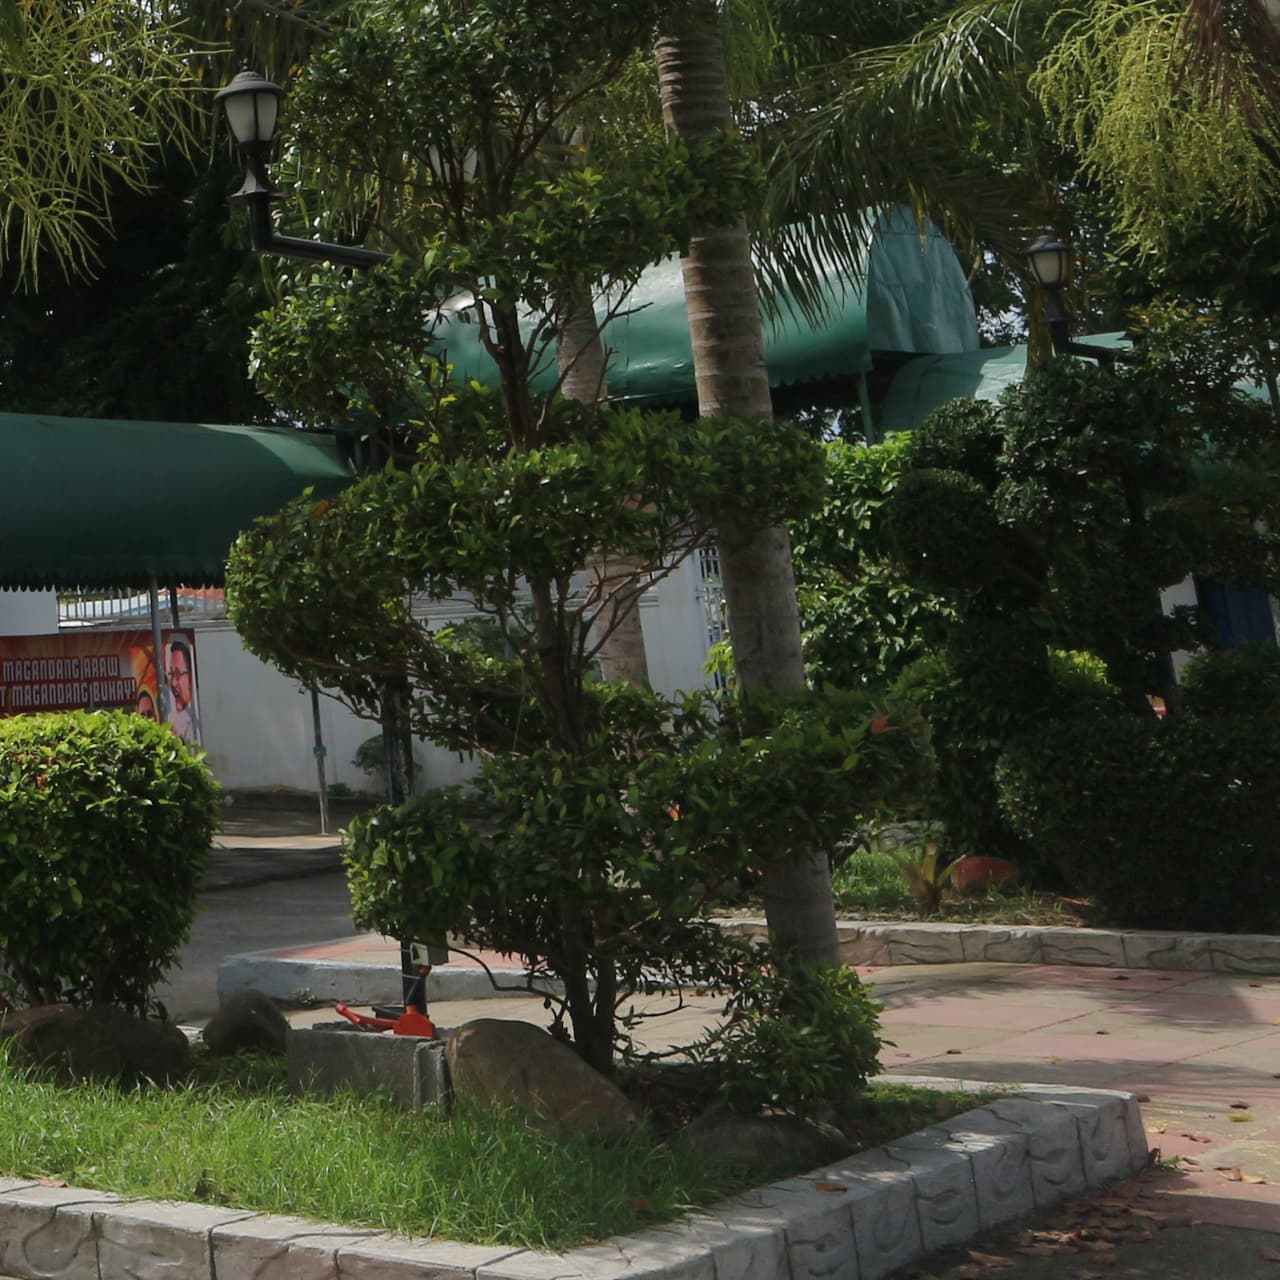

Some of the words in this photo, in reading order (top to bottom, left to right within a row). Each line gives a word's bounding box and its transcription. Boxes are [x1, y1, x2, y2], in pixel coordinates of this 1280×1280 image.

[2, 659, 81, 682] MAGANDANG
[83, 656, 119, 678] ARAW
[11, 682, 89, 706] MAGANDANG
[92, 679, 137, 704] BUHAY!
